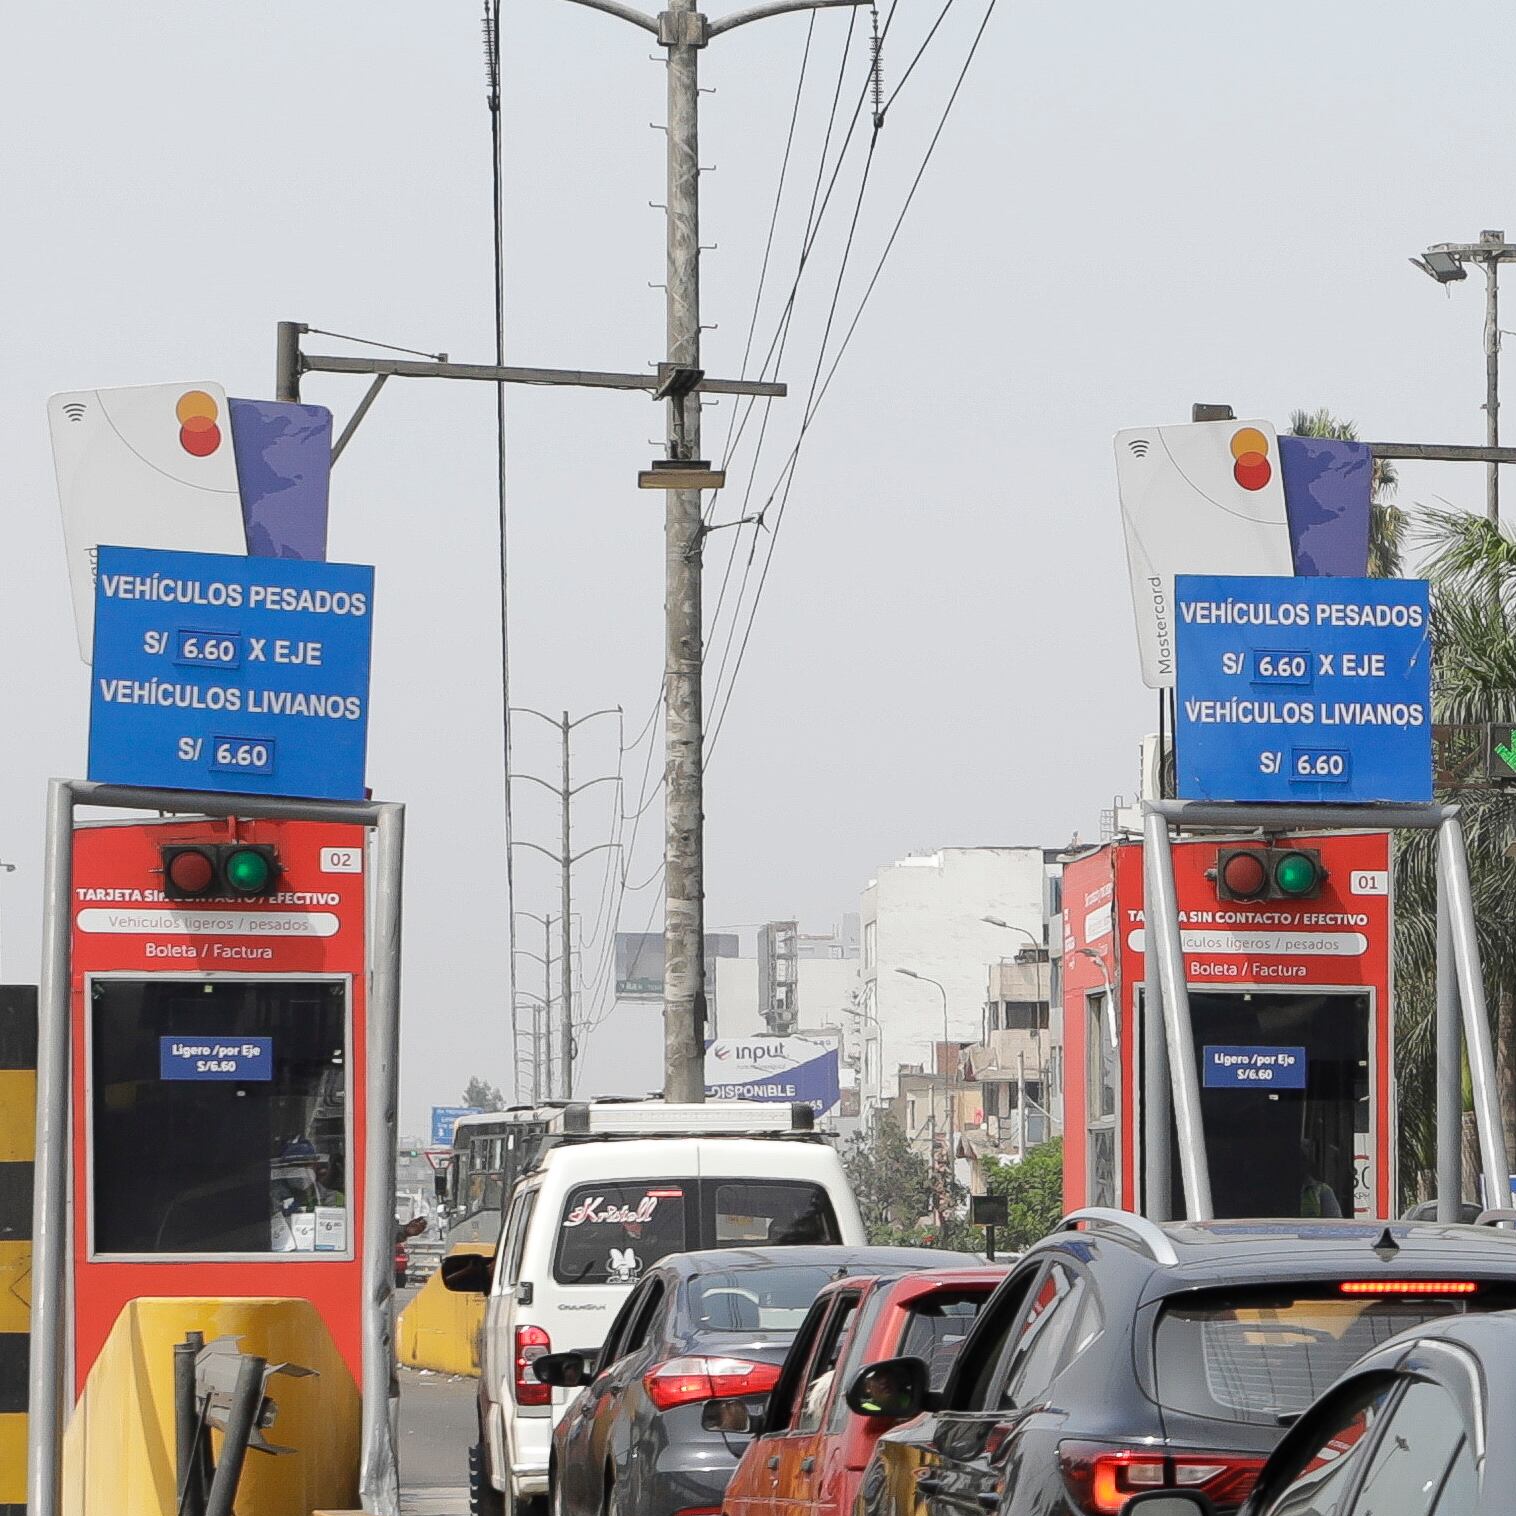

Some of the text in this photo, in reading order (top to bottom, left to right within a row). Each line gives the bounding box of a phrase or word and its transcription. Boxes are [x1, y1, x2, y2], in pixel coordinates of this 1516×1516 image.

[101, 574, 367, 617] VEHÍCULOS PESADOS
[1180, 597, 1423, 628] VEHÍCULOS PESADOS
[1148, 577, 1173, 674] Mastercard
[143, 631, 322, 666] S/ 6.60 X EJE
[1222, 653, 1386, 677] S/ 6.60 X EJE
[100, 678, 361, 720] VEHÍCULOS LIVIANOS
[1185, 696, 1424, 726] VEHÍCULOS LIVIANOS
[178, 738, 268, 766] S/ 6.60
[1259, 752, 1343, 775] S/ 6.60
[331, 852, 352, 867] 02
[1358, 875, 1378, 890] 01
[76, 888, 143, 902] TARJETA
[184, 917, 234, 934] ligeros
[249, 917, 308, 933] pesados
[1190, 911, 1213, 923] SIN
[1215, 911, 1292, 925] CONTACTO
[1303, 914, 1368, 926] EFECTIVO
[145, 943, 273, 959] Boleta / Factura
[1226, 936, 1271, 954] ligeros
[1285, 937, 1339, 952] pesados
[1190, 961, 1307, 977] Boleta / Factura
[171, 1044, 211, 1058] Ligero
[241, 1044, 261, 1058] Eje
[736, 1042, 785, 1063] input
[1214, 1053, 1249, 1066] Ligero
[1277, 1054, 1296, 1066] Eje
[1236, 1068, 1273, 1080] S/6.60
[711, 1085, 796, 1099] DISPONIBLE
